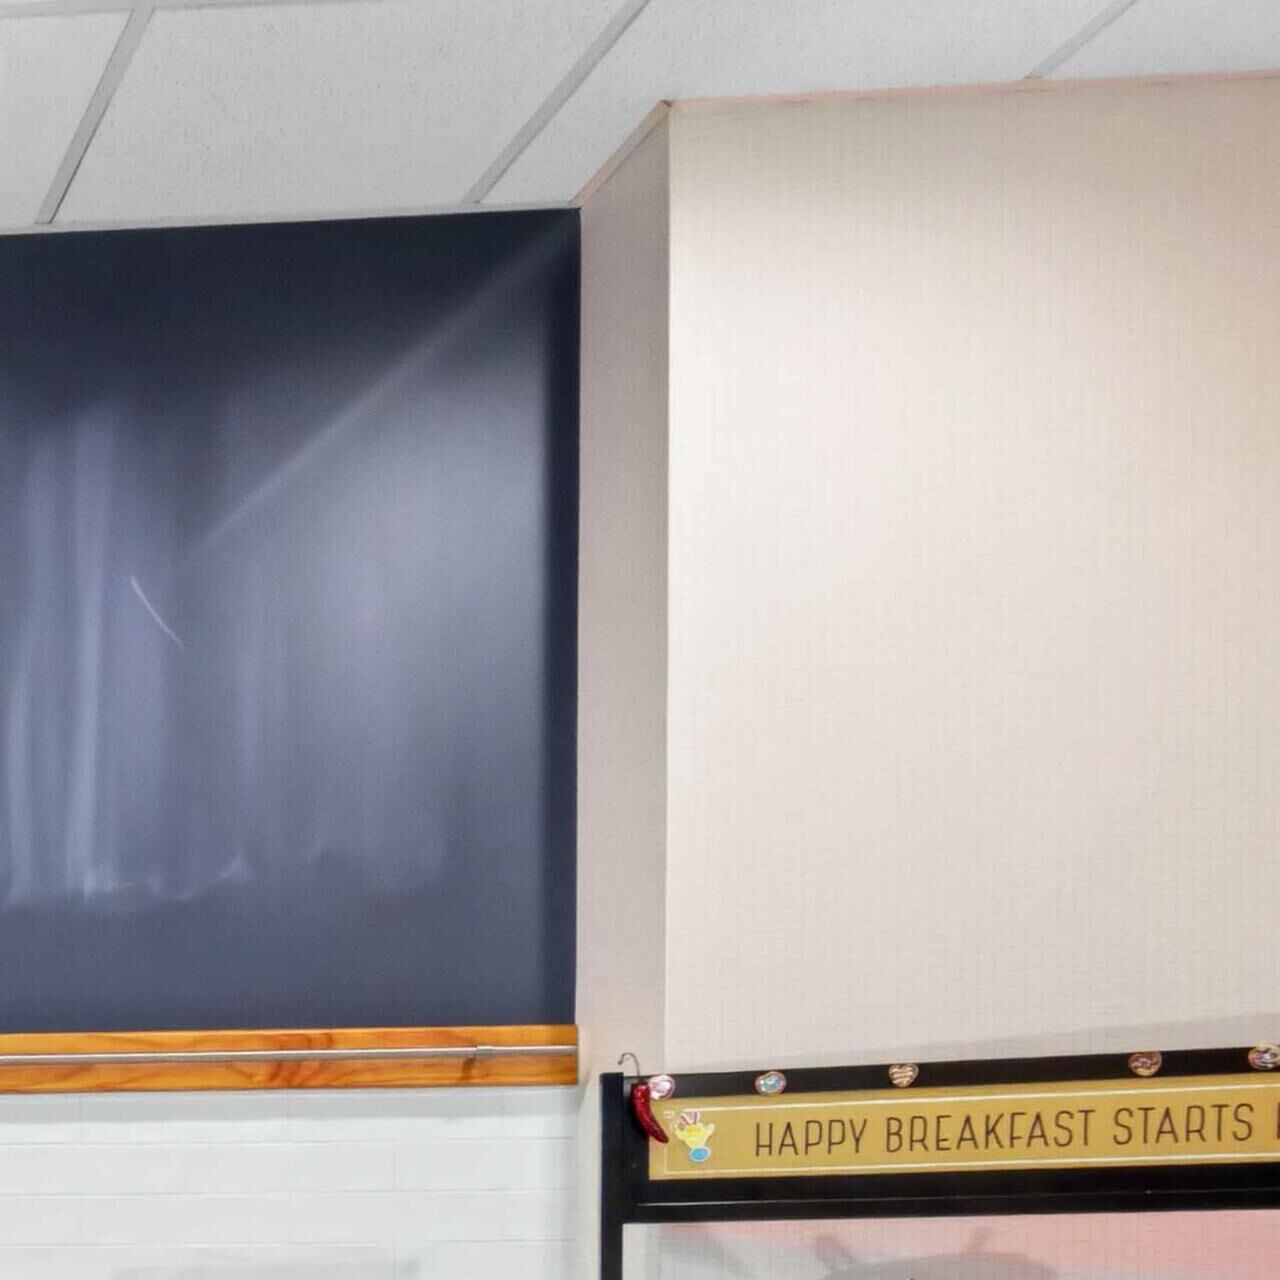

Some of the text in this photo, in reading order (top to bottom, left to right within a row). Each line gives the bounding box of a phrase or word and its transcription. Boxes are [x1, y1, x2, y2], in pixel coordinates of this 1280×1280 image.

[754, 1118, 867, 1157] HAPPY
[886, 1109, 1096, 1153] BREAKFAST
[1113, 1103, 1254, 1145] STARTS
